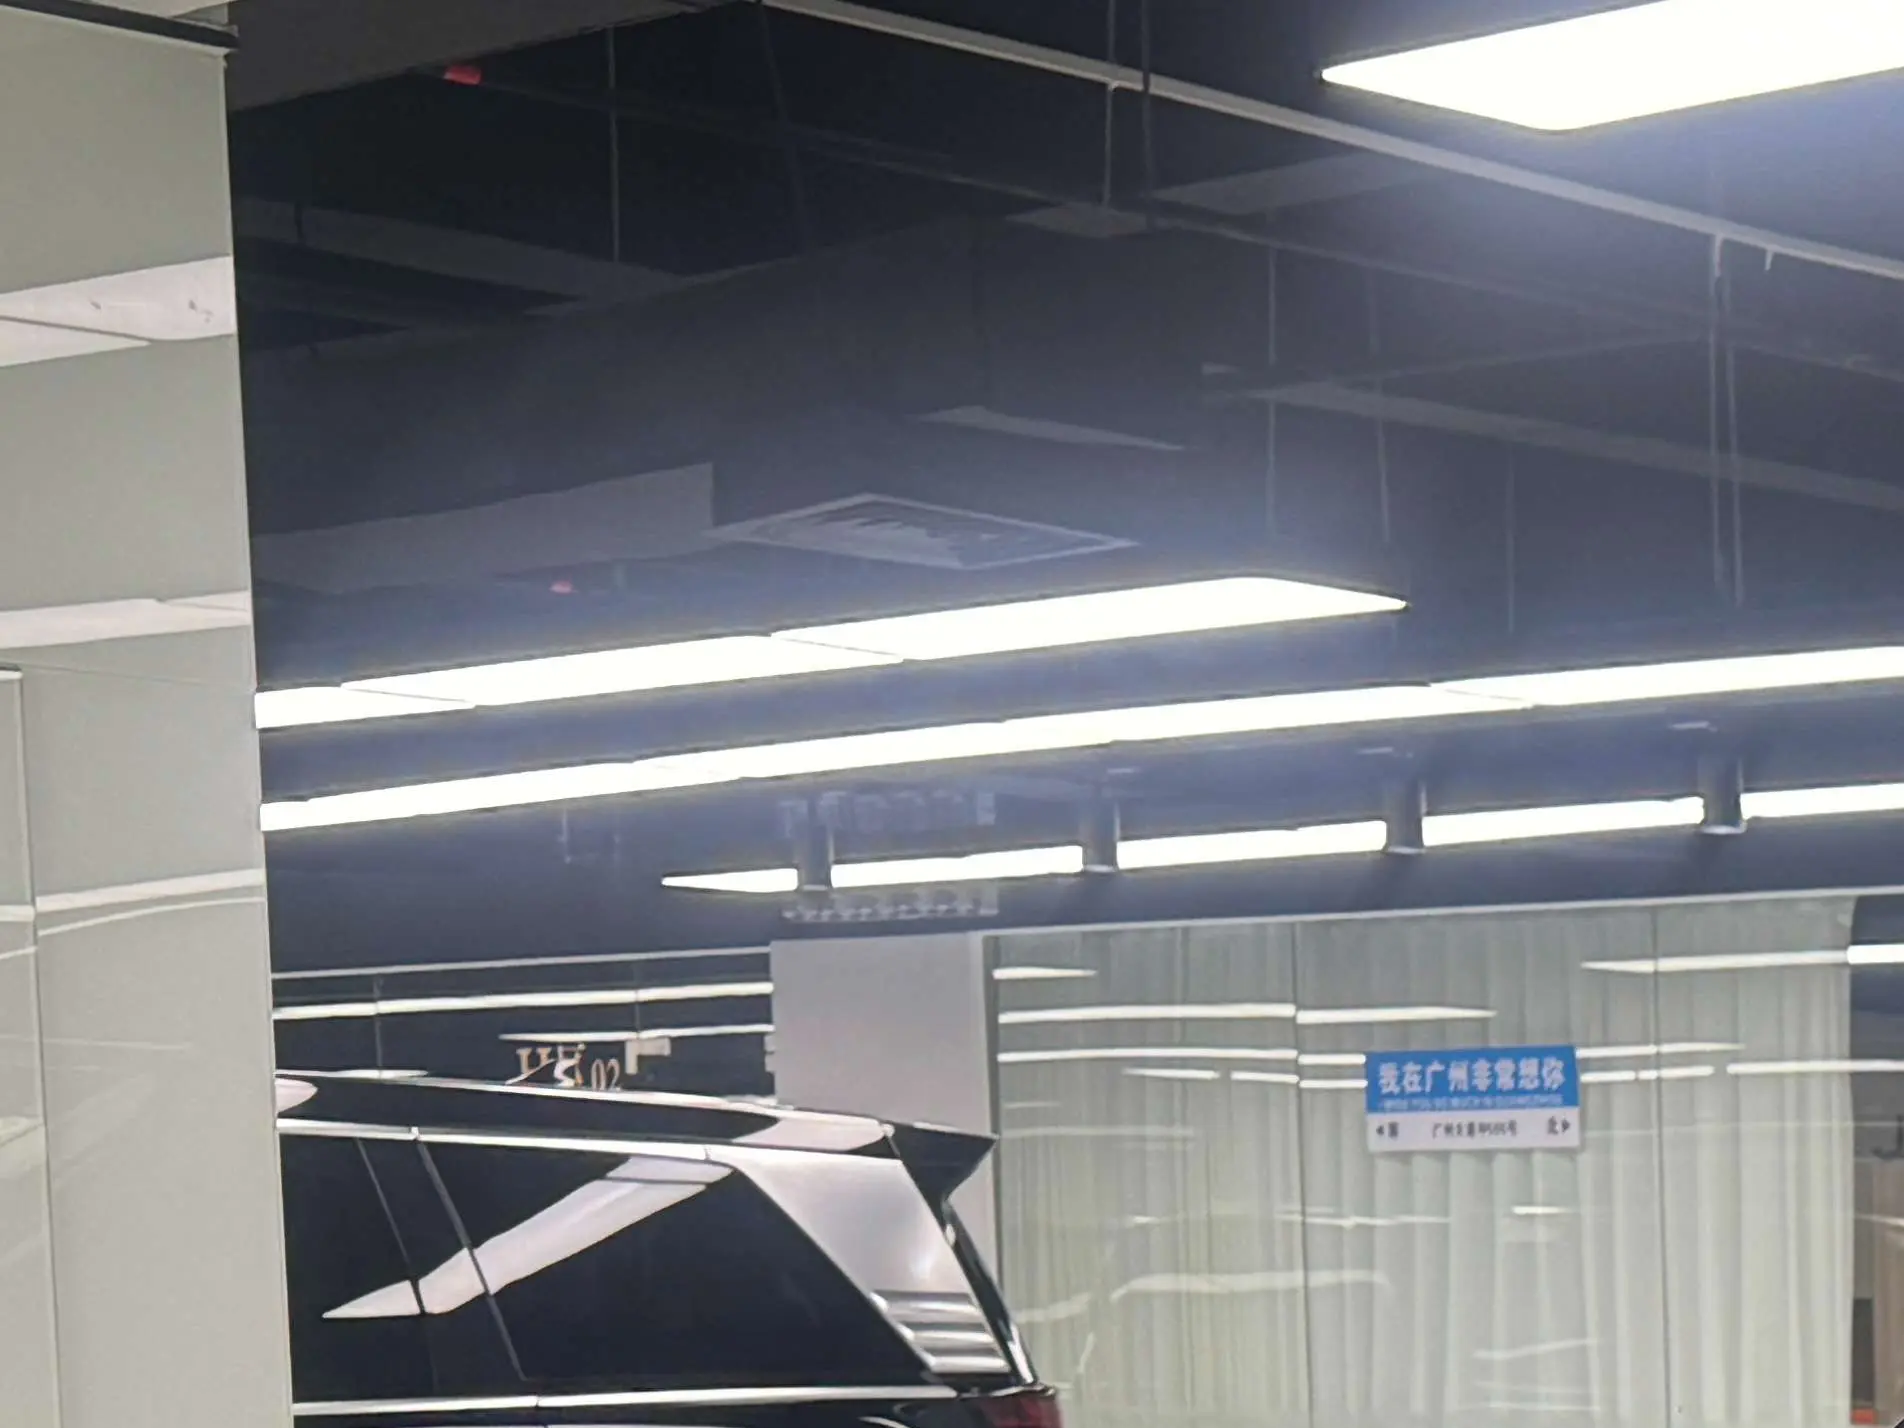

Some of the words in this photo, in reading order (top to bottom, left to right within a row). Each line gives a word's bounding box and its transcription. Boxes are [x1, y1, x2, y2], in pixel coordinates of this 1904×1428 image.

[1377, 1056, 1566, 1094] 我在广州非常想你
